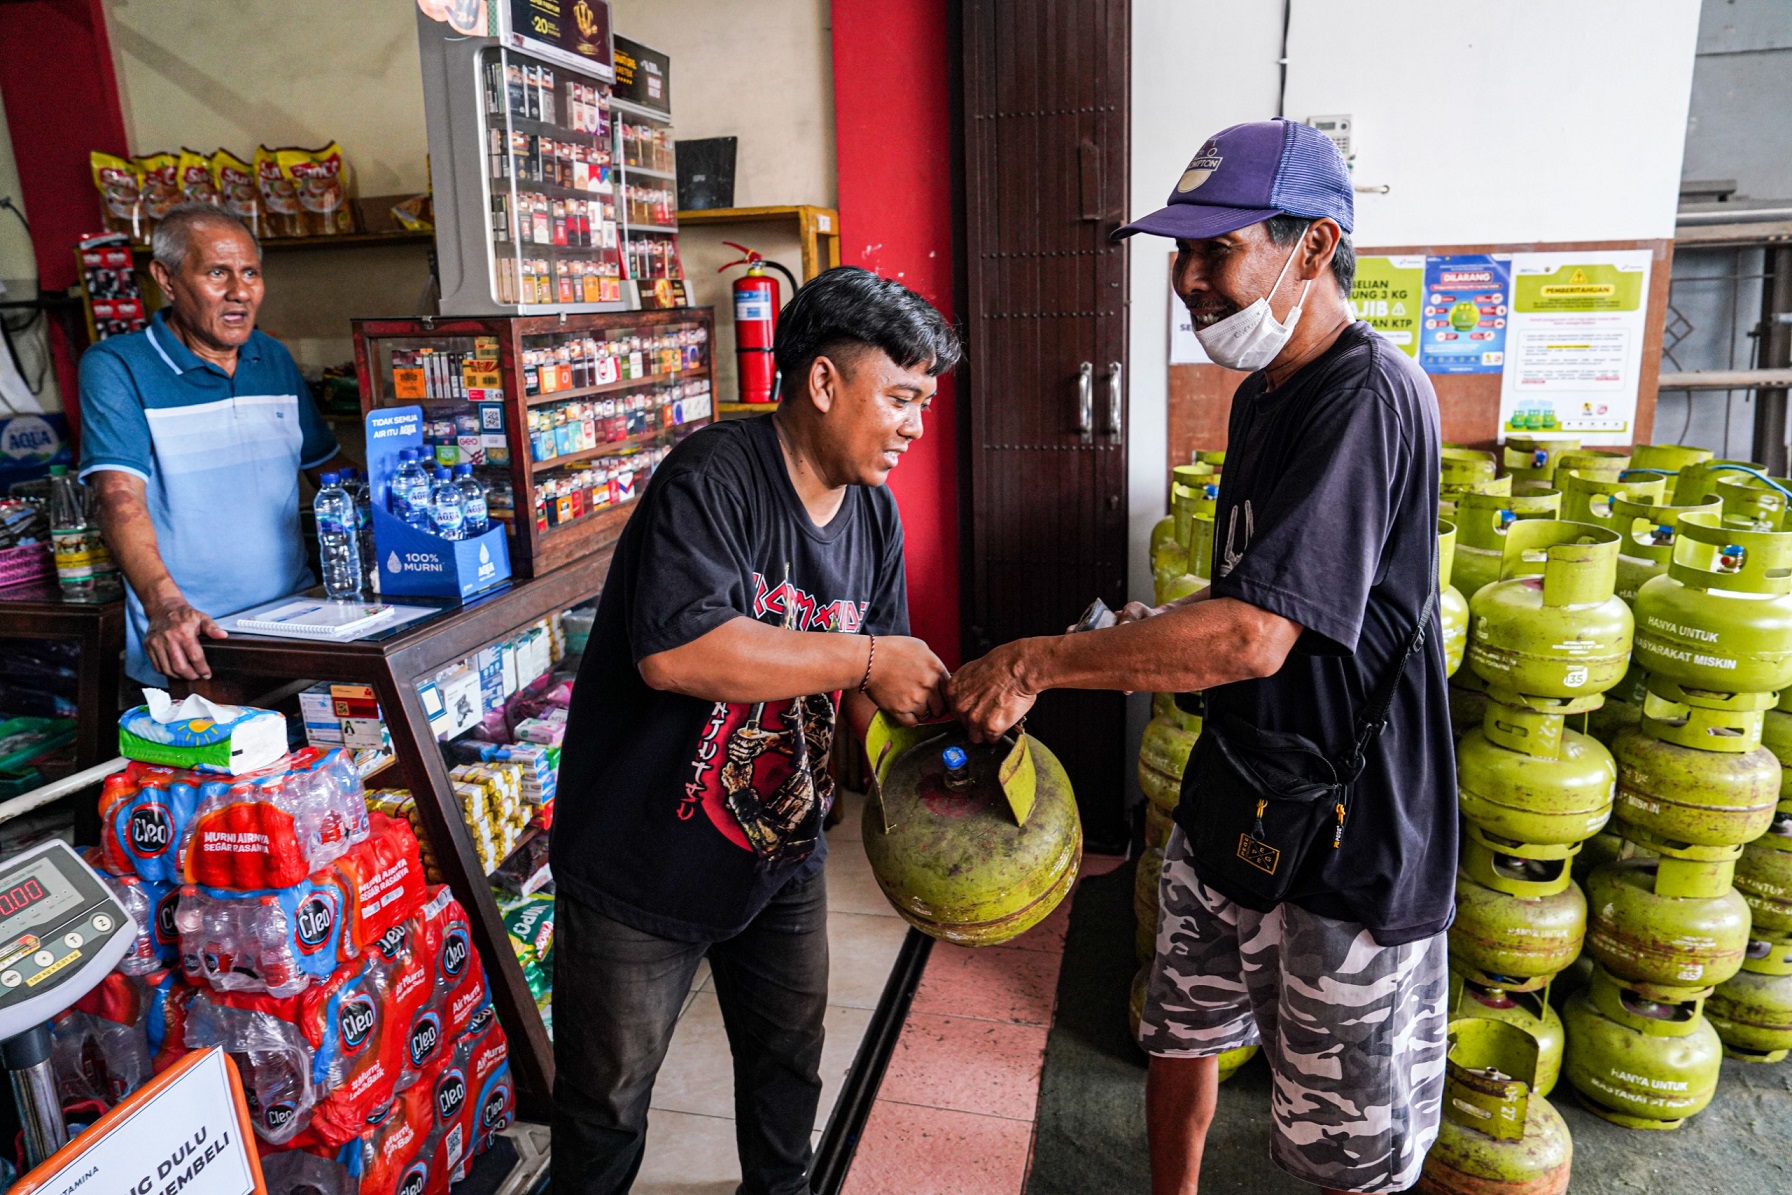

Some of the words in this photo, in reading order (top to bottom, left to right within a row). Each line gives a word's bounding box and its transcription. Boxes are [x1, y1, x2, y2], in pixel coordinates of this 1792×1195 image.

[1189, 159, 1218, 169] OMPTON
[1443, 272, 1491, 283] DILARANG
[1381, 290, 1388, 299] 3
[1391, 290, 1408, 299] KG
[1545, 286, 1610, 295] PEMBERITAHUAN
[1392, 319, 1413, 328] KTP
[372, 418, 393, 427] TIDAK
[393, 414, 418, 424] SEMUA
[8, 431, 53, 450] AQUA
[373, 431, 386, 439] AIR
[386, 428, 399, 437] ITU
[410, 491, 428, 503] AQU
[436, 511, 461, 521] AQUA
[467, 503, 486, 515] AQUA
[405, 552, 439, 564] 100%
[404, 562, 443, 572] MURNI
[1648, 616, 1677, 633] HANYA
[1679, 626, 1719, 642] UNTUK
[1693, 655, 1737, 670] MISKIN
[133, 817, 169, 845] Cleo
[204, 831, 237, 843] MURNI
[237, 831, 270, 845] AIRNYA
[203, 843, 233, 853] SEGAR
[233, 843, 270, 855] RASANYA
[359, 874, 382, 894] MURNI
[299, 908, 331, 939] Cleo
[383, 925, 406, 953] leo
[445, 941, 466, 969] Cleo
[402, 965, 425, 988] Murni
[453, 997, 463, 1014] Air
[461, 981, 480, 1007] Murni
[342, 1009, 374, 1041] Cleo
[412, 1026, 437, 1060] Cleo
[483, 1041, 507, 1064] Murni
[352, 1060, 380, 1090] #Murni
[1651, 1080, 1689, 1091] UNTUK
[440, 1083, 464, 1113] Cleo
[485, 1097, 504, 1124] Cleo
[156, 1125, 208, 1181] DULU
